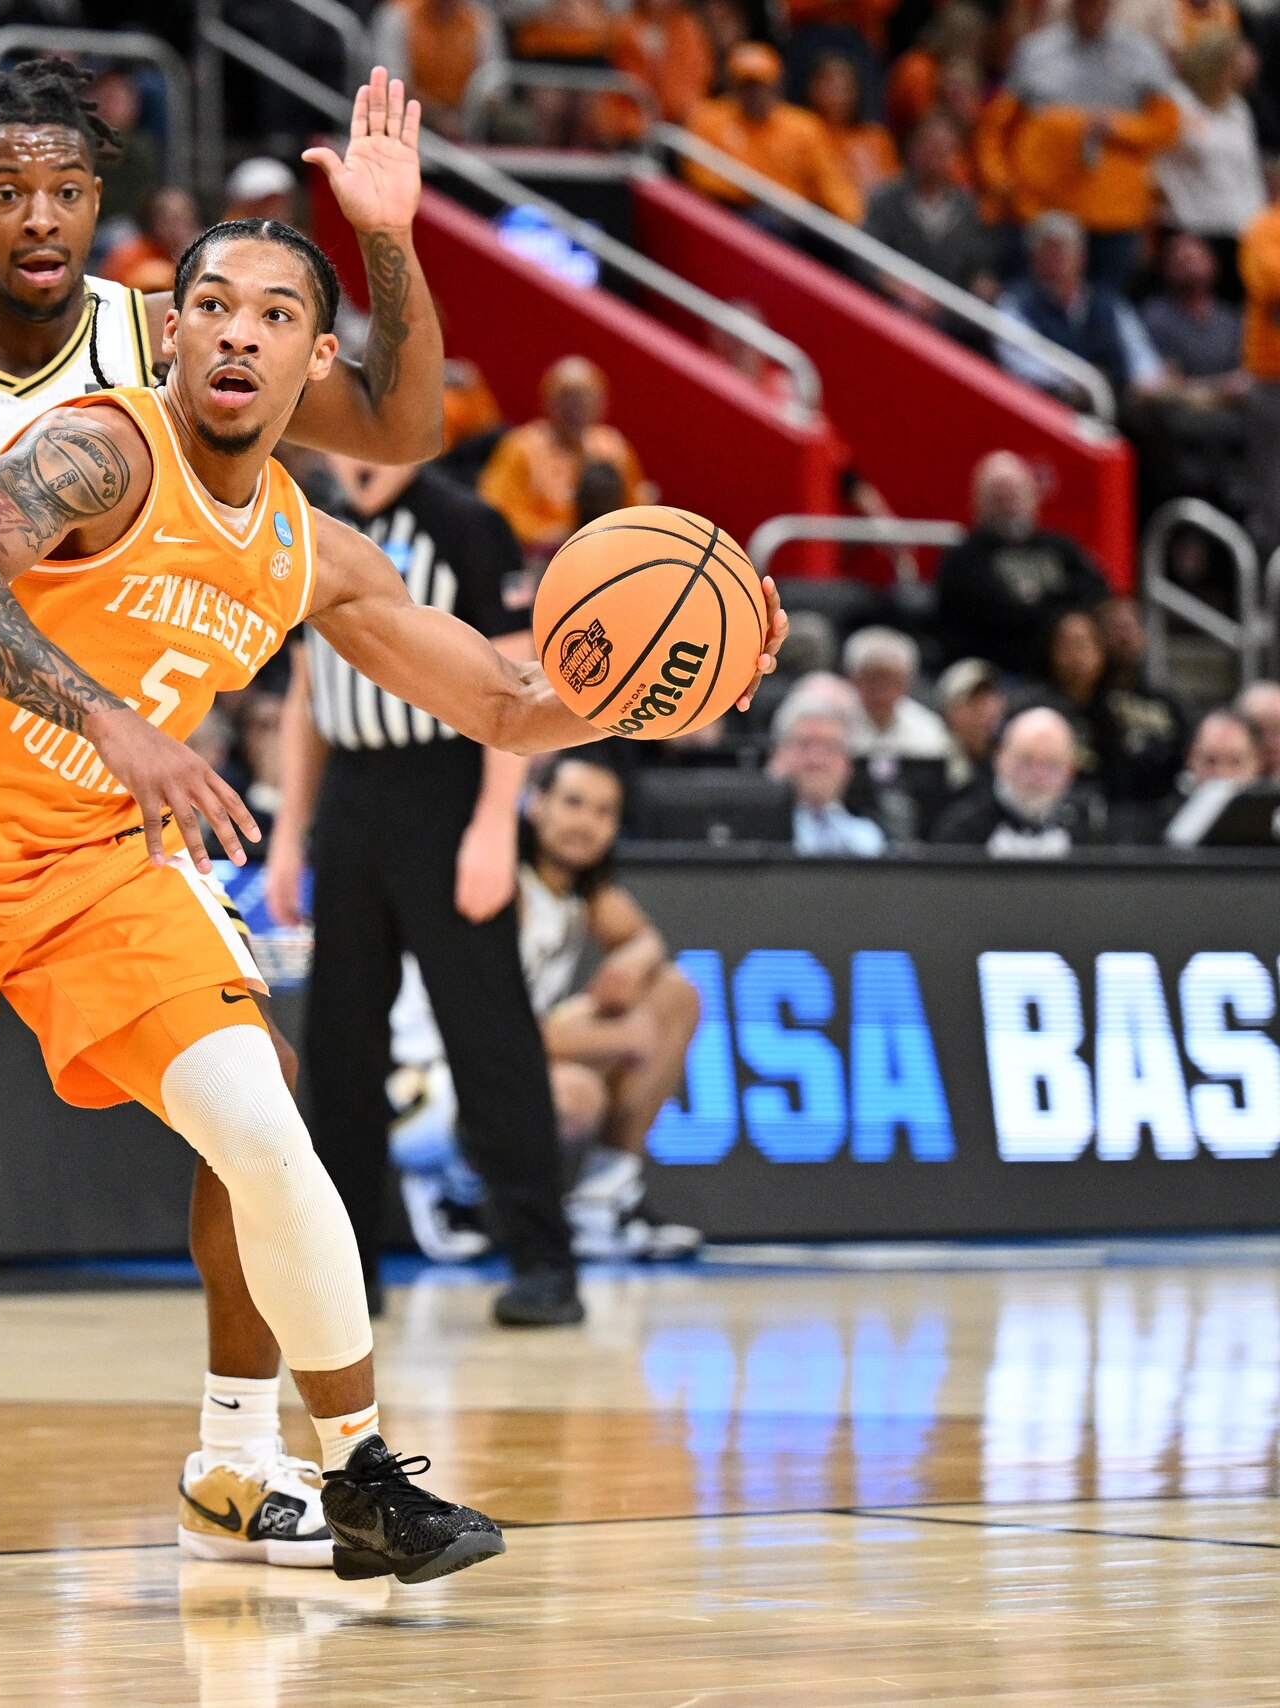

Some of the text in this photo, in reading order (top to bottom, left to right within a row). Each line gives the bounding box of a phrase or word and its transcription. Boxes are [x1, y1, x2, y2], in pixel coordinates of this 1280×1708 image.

[271, 552, 291, 577] SEC
[104, 574, 277, 676] TENNESSEE
[122, 646, 210, 729] 5
[560, 639, 593, 682] MADNESS
[576, 645, 604, 682] MARCH
[602, 640, 710, 737] Wilson
[619, 683, 647, 714] EVO NXT
[977, 951, 1280, 1162] BAS
